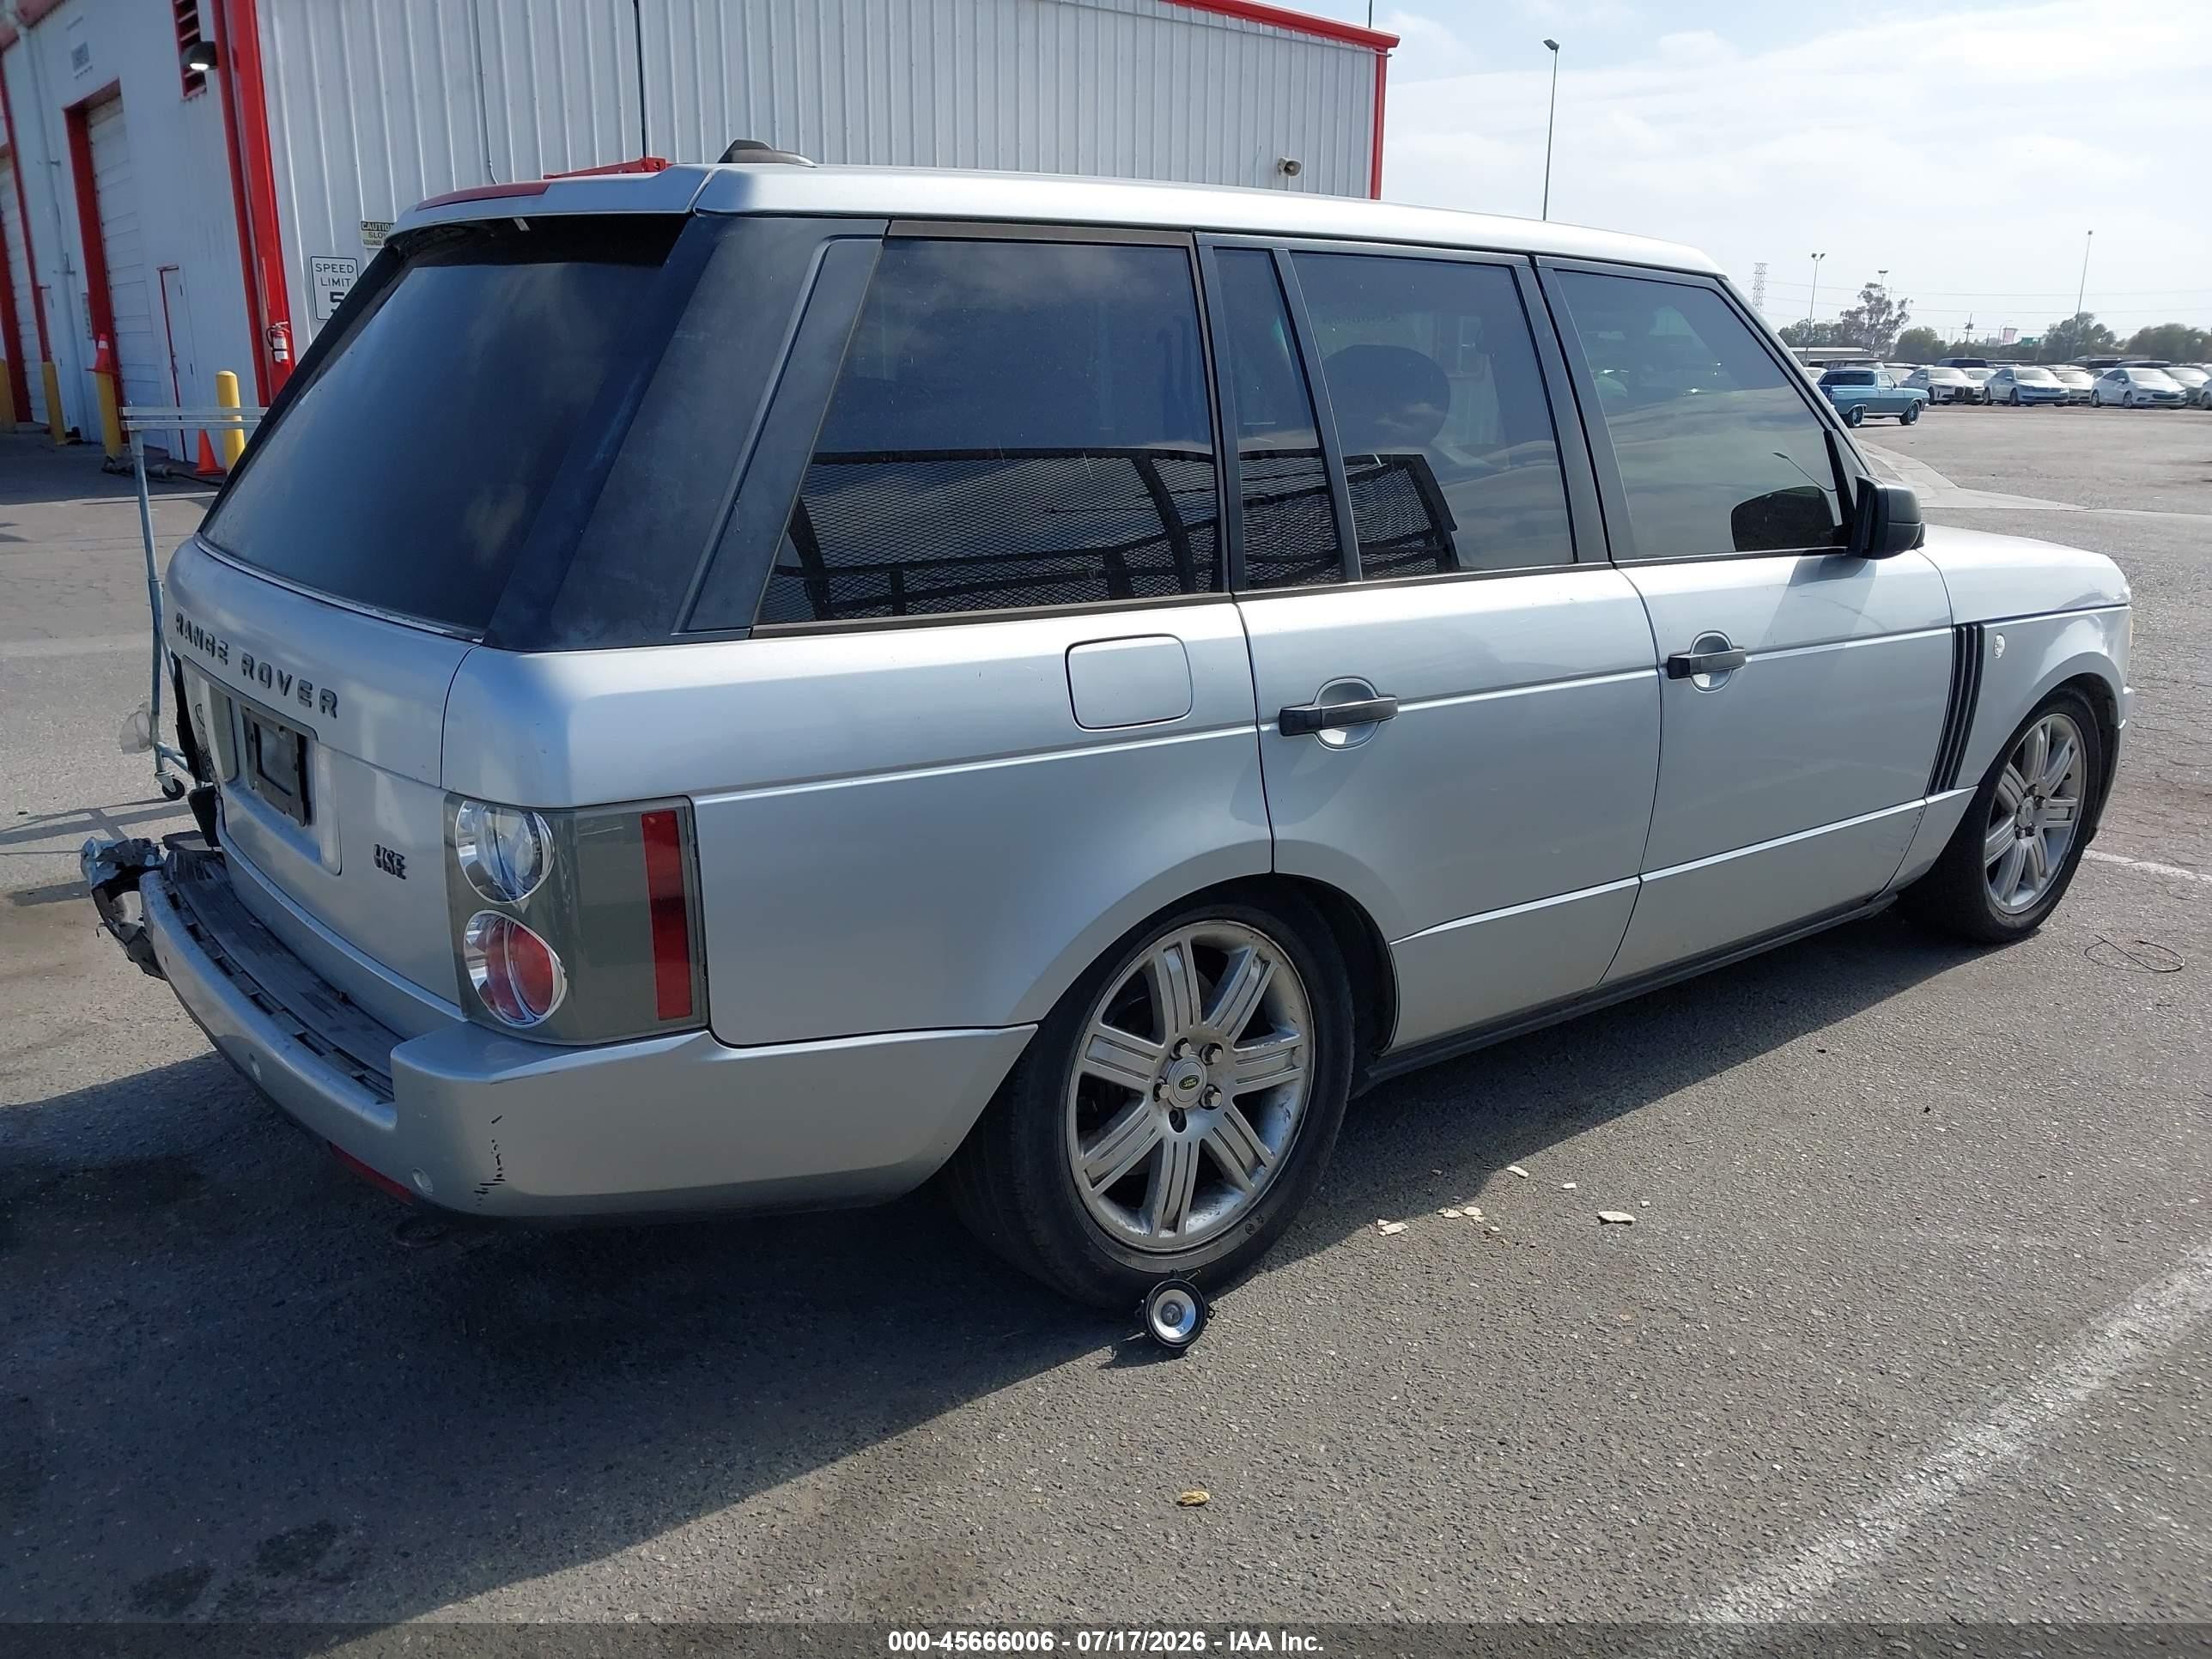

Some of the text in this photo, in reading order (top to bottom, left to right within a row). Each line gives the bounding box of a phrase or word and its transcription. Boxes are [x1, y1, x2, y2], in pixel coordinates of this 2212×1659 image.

[362, 222, 392, 231] CAUTIO
[315, 263, 355, 274] SPEED
[320, 276, 351, 288] LIMIT
[175, 612, 337, 719] RANGE ROVER
[373, 843, 407, 880] HSE
